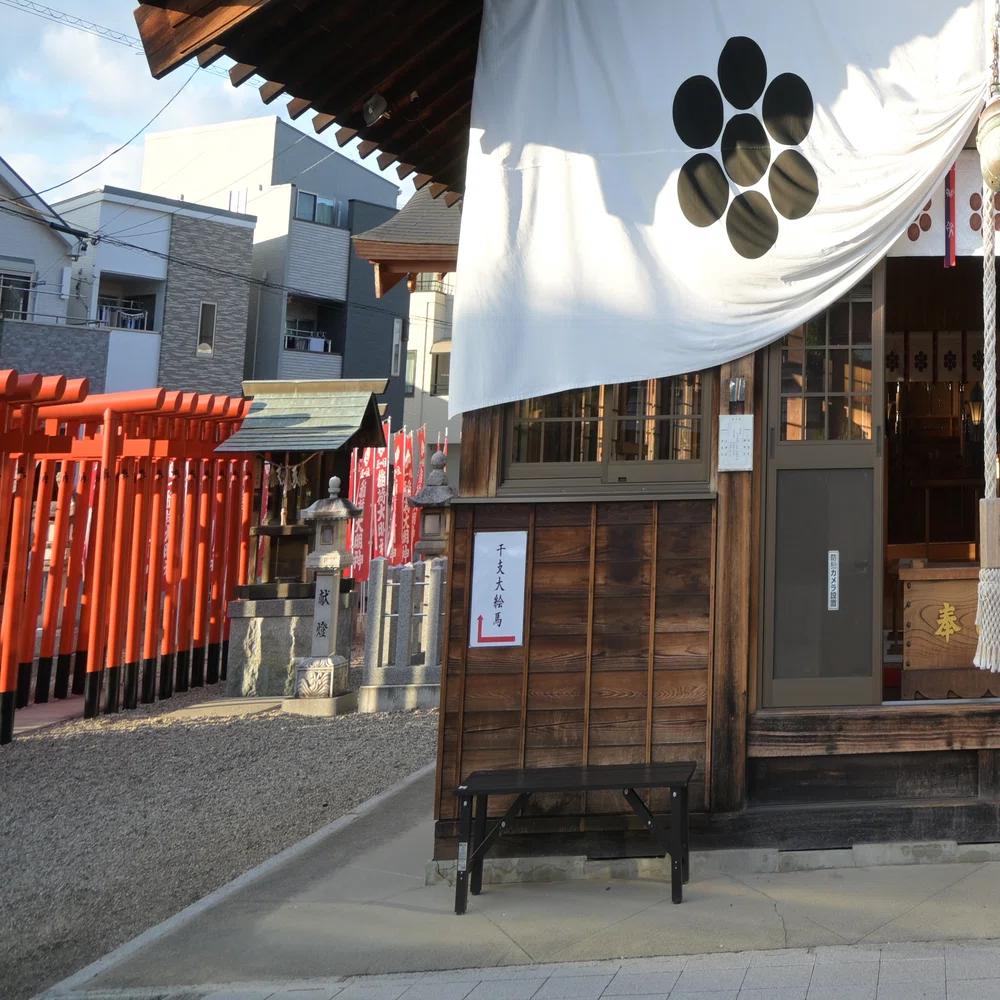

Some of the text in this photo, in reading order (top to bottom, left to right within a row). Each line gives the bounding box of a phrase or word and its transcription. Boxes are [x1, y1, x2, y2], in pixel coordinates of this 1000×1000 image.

[492, 543, 506, 628] 干支大絵馬
